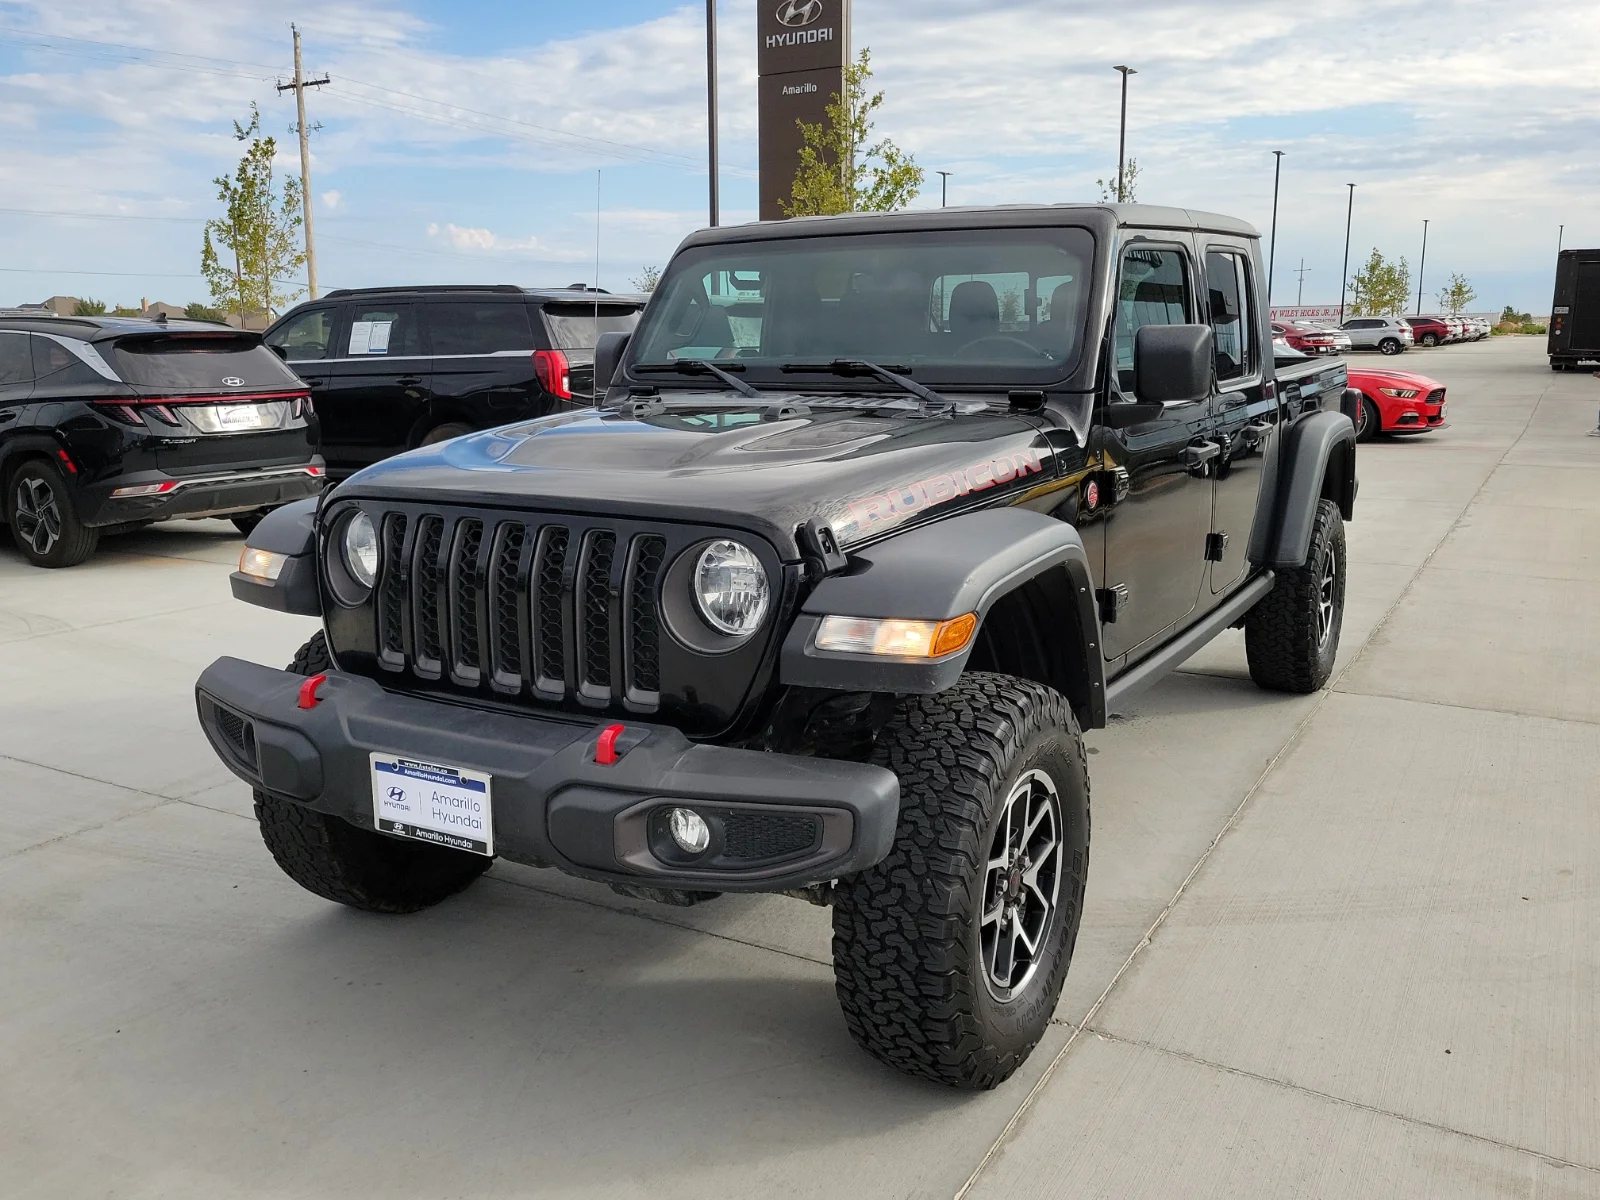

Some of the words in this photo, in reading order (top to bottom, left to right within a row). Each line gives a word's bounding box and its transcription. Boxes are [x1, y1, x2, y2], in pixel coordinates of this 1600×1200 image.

[766, 27, 833, 49] HYUNDAI
[782, 83, 817, 95] Amarillo
[1300, 308, 1320, 317] HICKS
[849, 450, 1042, 530] RUBICON
[404, 768, 457, 785] AmarilloHyundai.com
[383, 800, 411, 812] HYUNDAI
[431, 790, 481, 813] Amarillo
[432, 807, 482, 829] Hyundai
[415, 828, 444, 842] Amarillo
[444, 833, 473, 849] Hyundai
